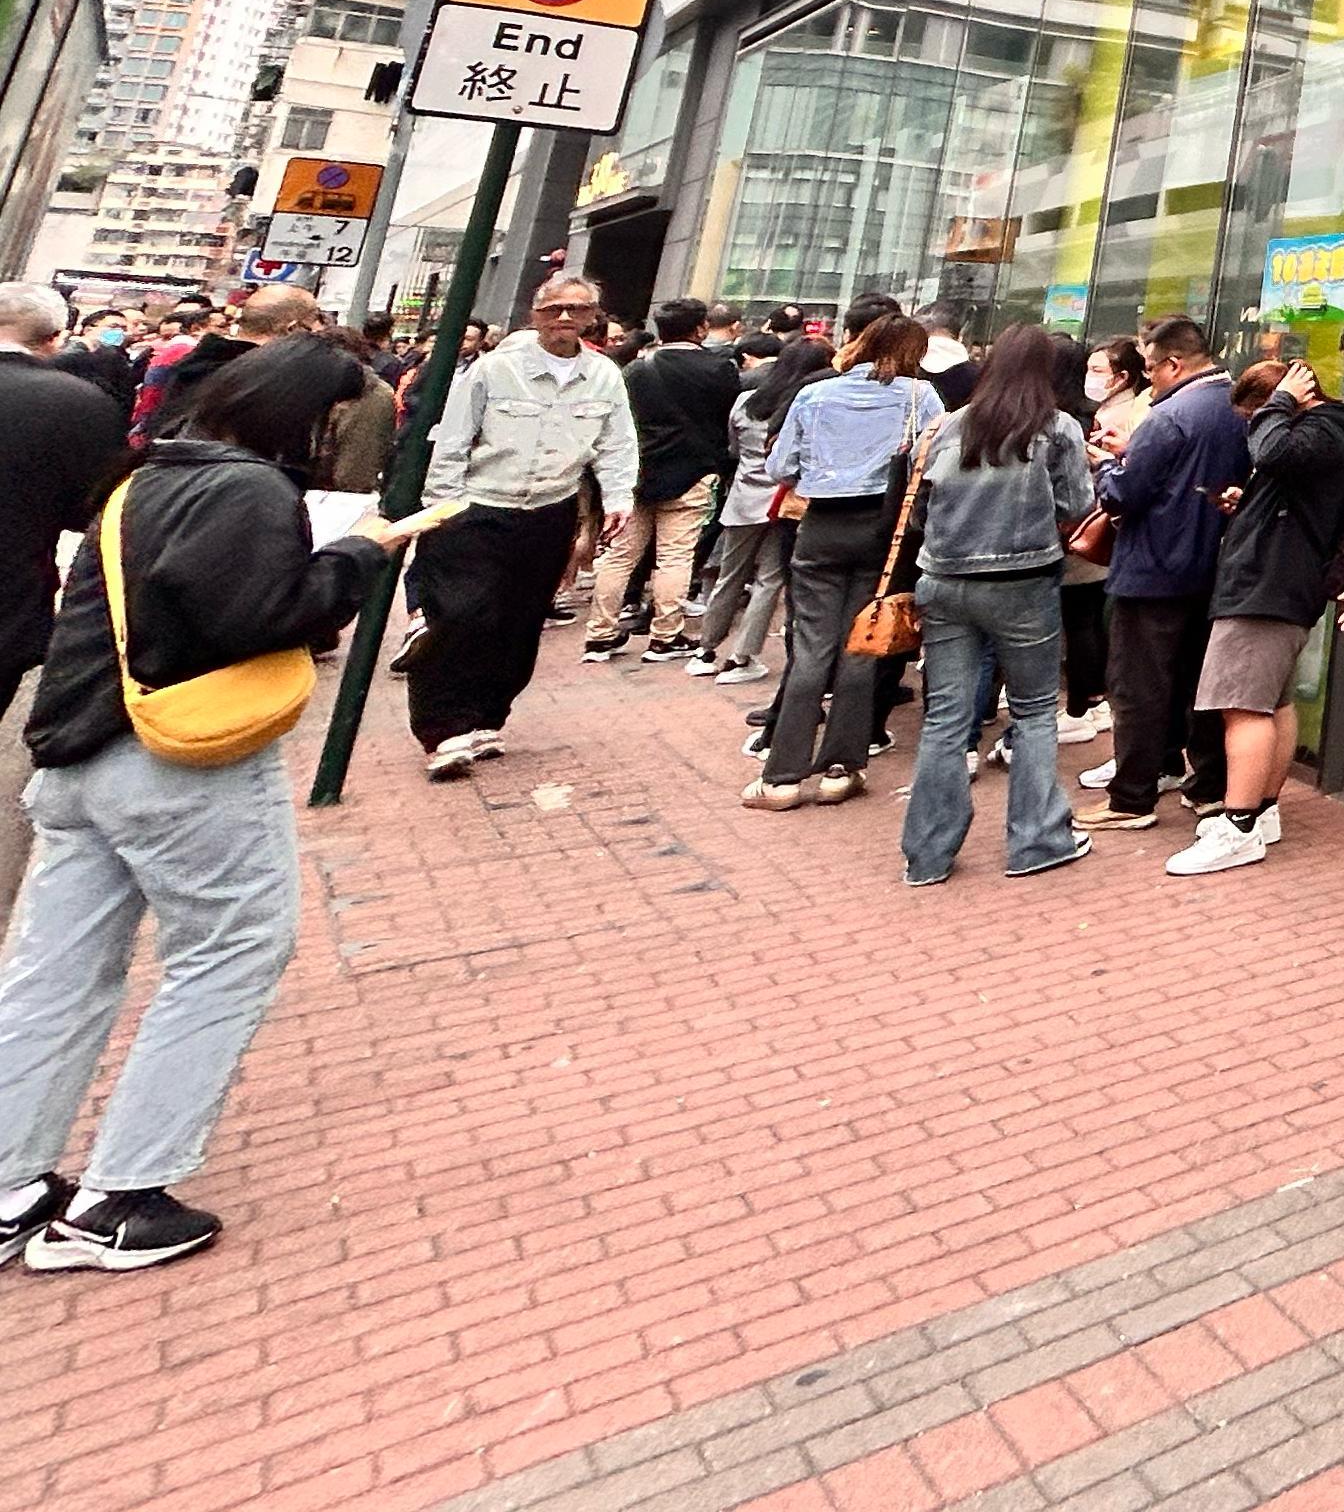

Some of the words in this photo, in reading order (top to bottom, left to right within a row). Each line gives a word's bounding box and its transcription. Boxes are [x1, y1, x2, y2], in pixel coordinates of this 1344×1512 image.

[491, 22, 584, 61] End
[459, 62, 582, 112] 終止
[335, 219, 351, 236] 7
[327, 246, 354, 264] 12
